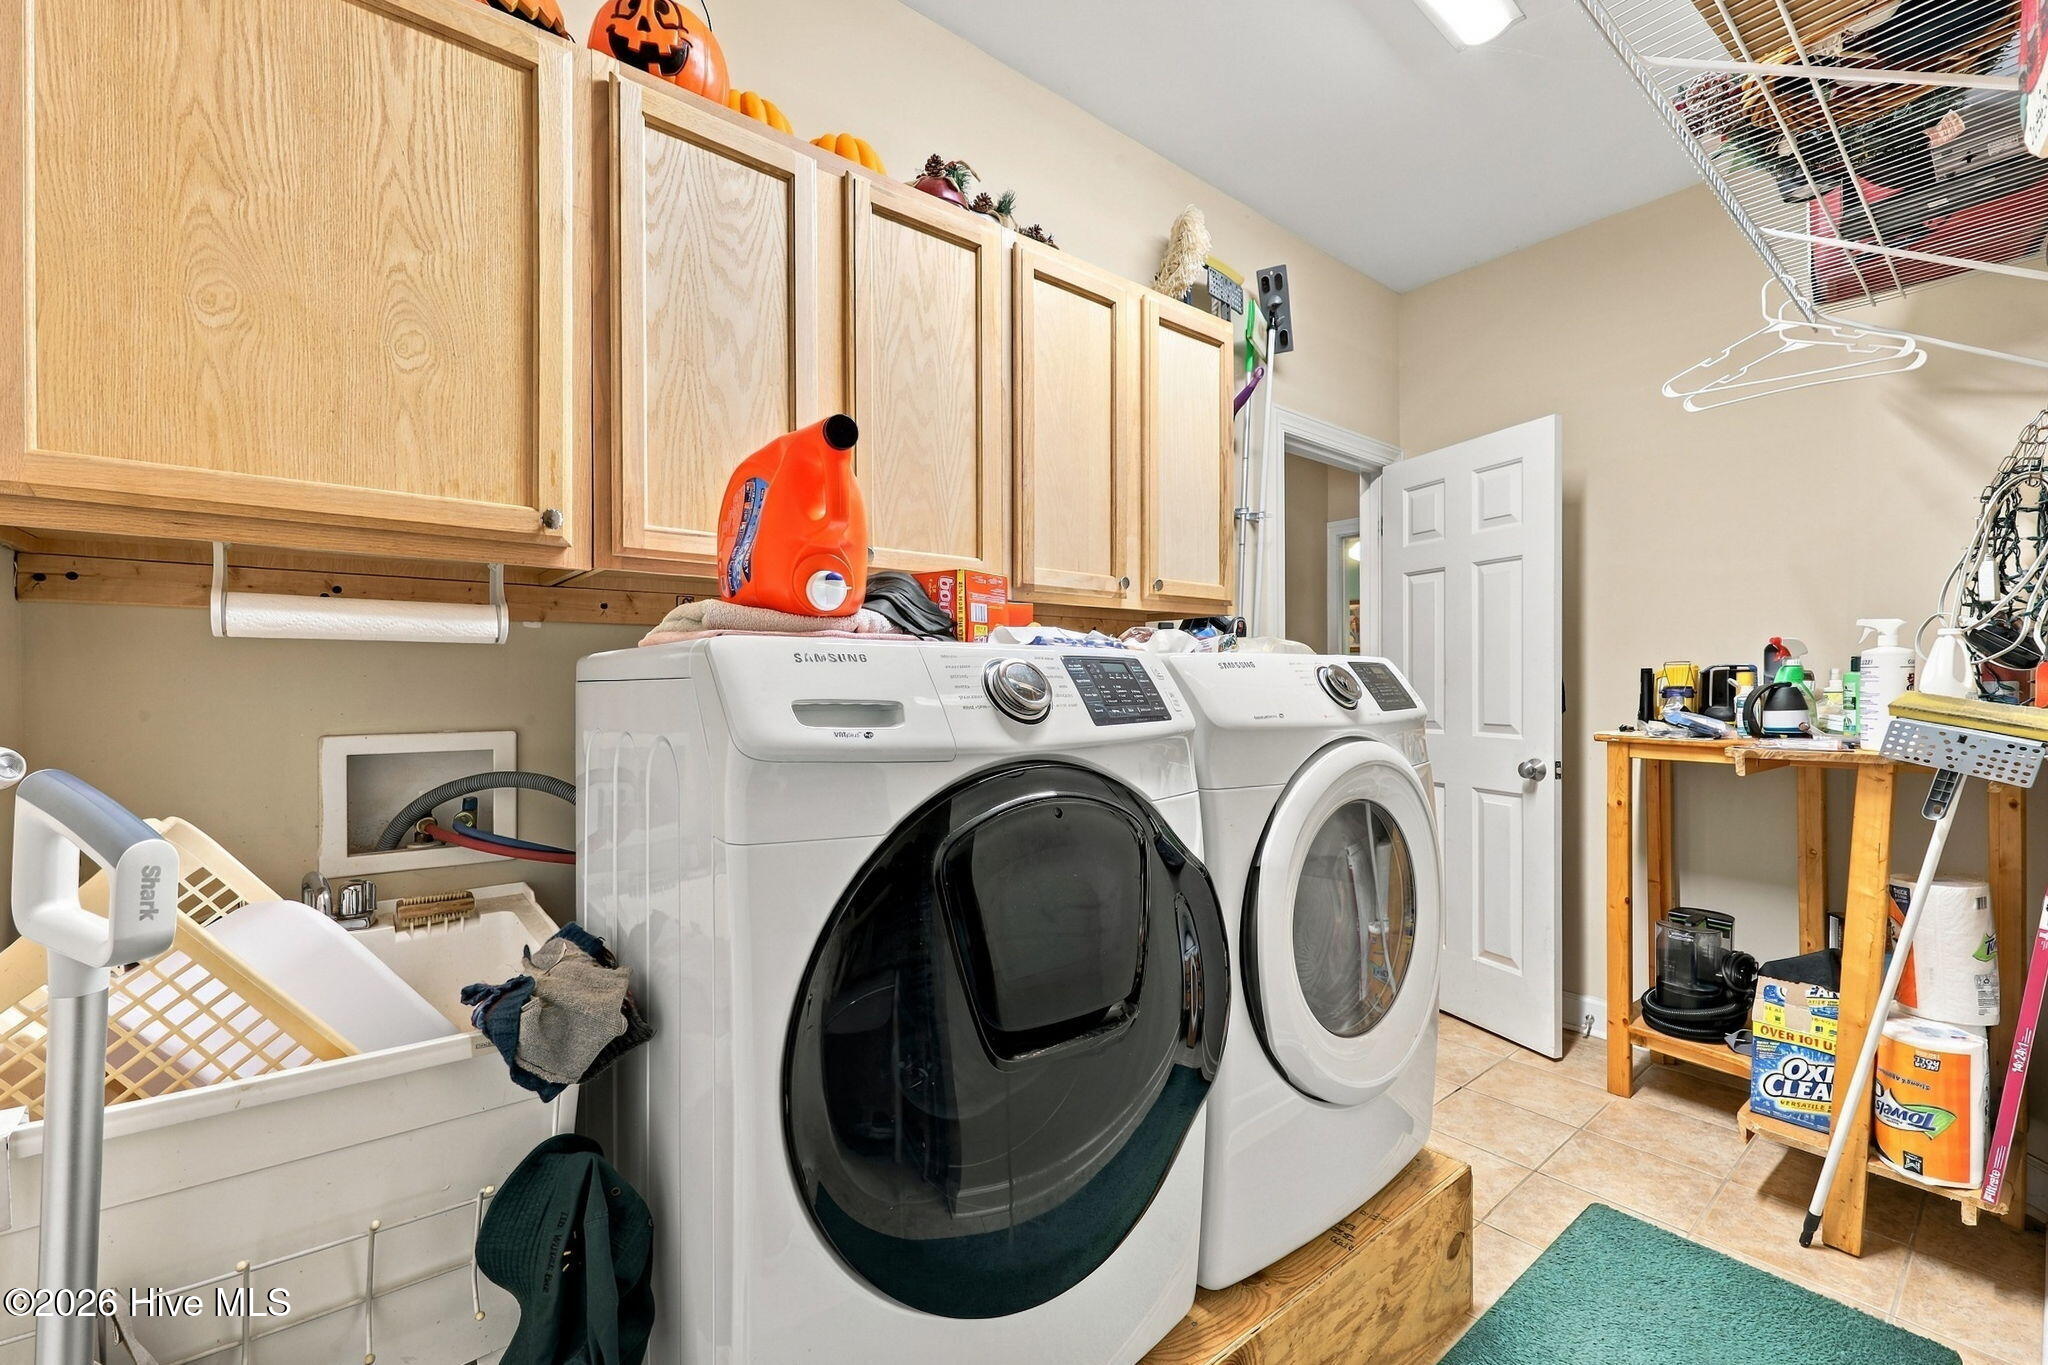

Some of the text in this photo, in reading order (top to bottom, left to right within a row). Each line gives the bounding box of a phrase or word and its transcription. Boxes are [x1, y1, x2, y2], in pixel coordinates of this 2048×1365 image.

[793, 652, 868, 663] SAMSUNG
[1217, 661, 1256, 669] SAMSUNG
[139, 865, 162, 921] Shark
[1760, 1025, 1795, 1041] OVER
[1798, 1034, 1819, 1047] 101
[1783, 1057, 1835, 1084] OXI
[1763, 1072, 1834, 1102] CLEA
[1780, 1100, 1826, 1110] VERSATILE
[1876, 1099, 1936, 1131] Towels
